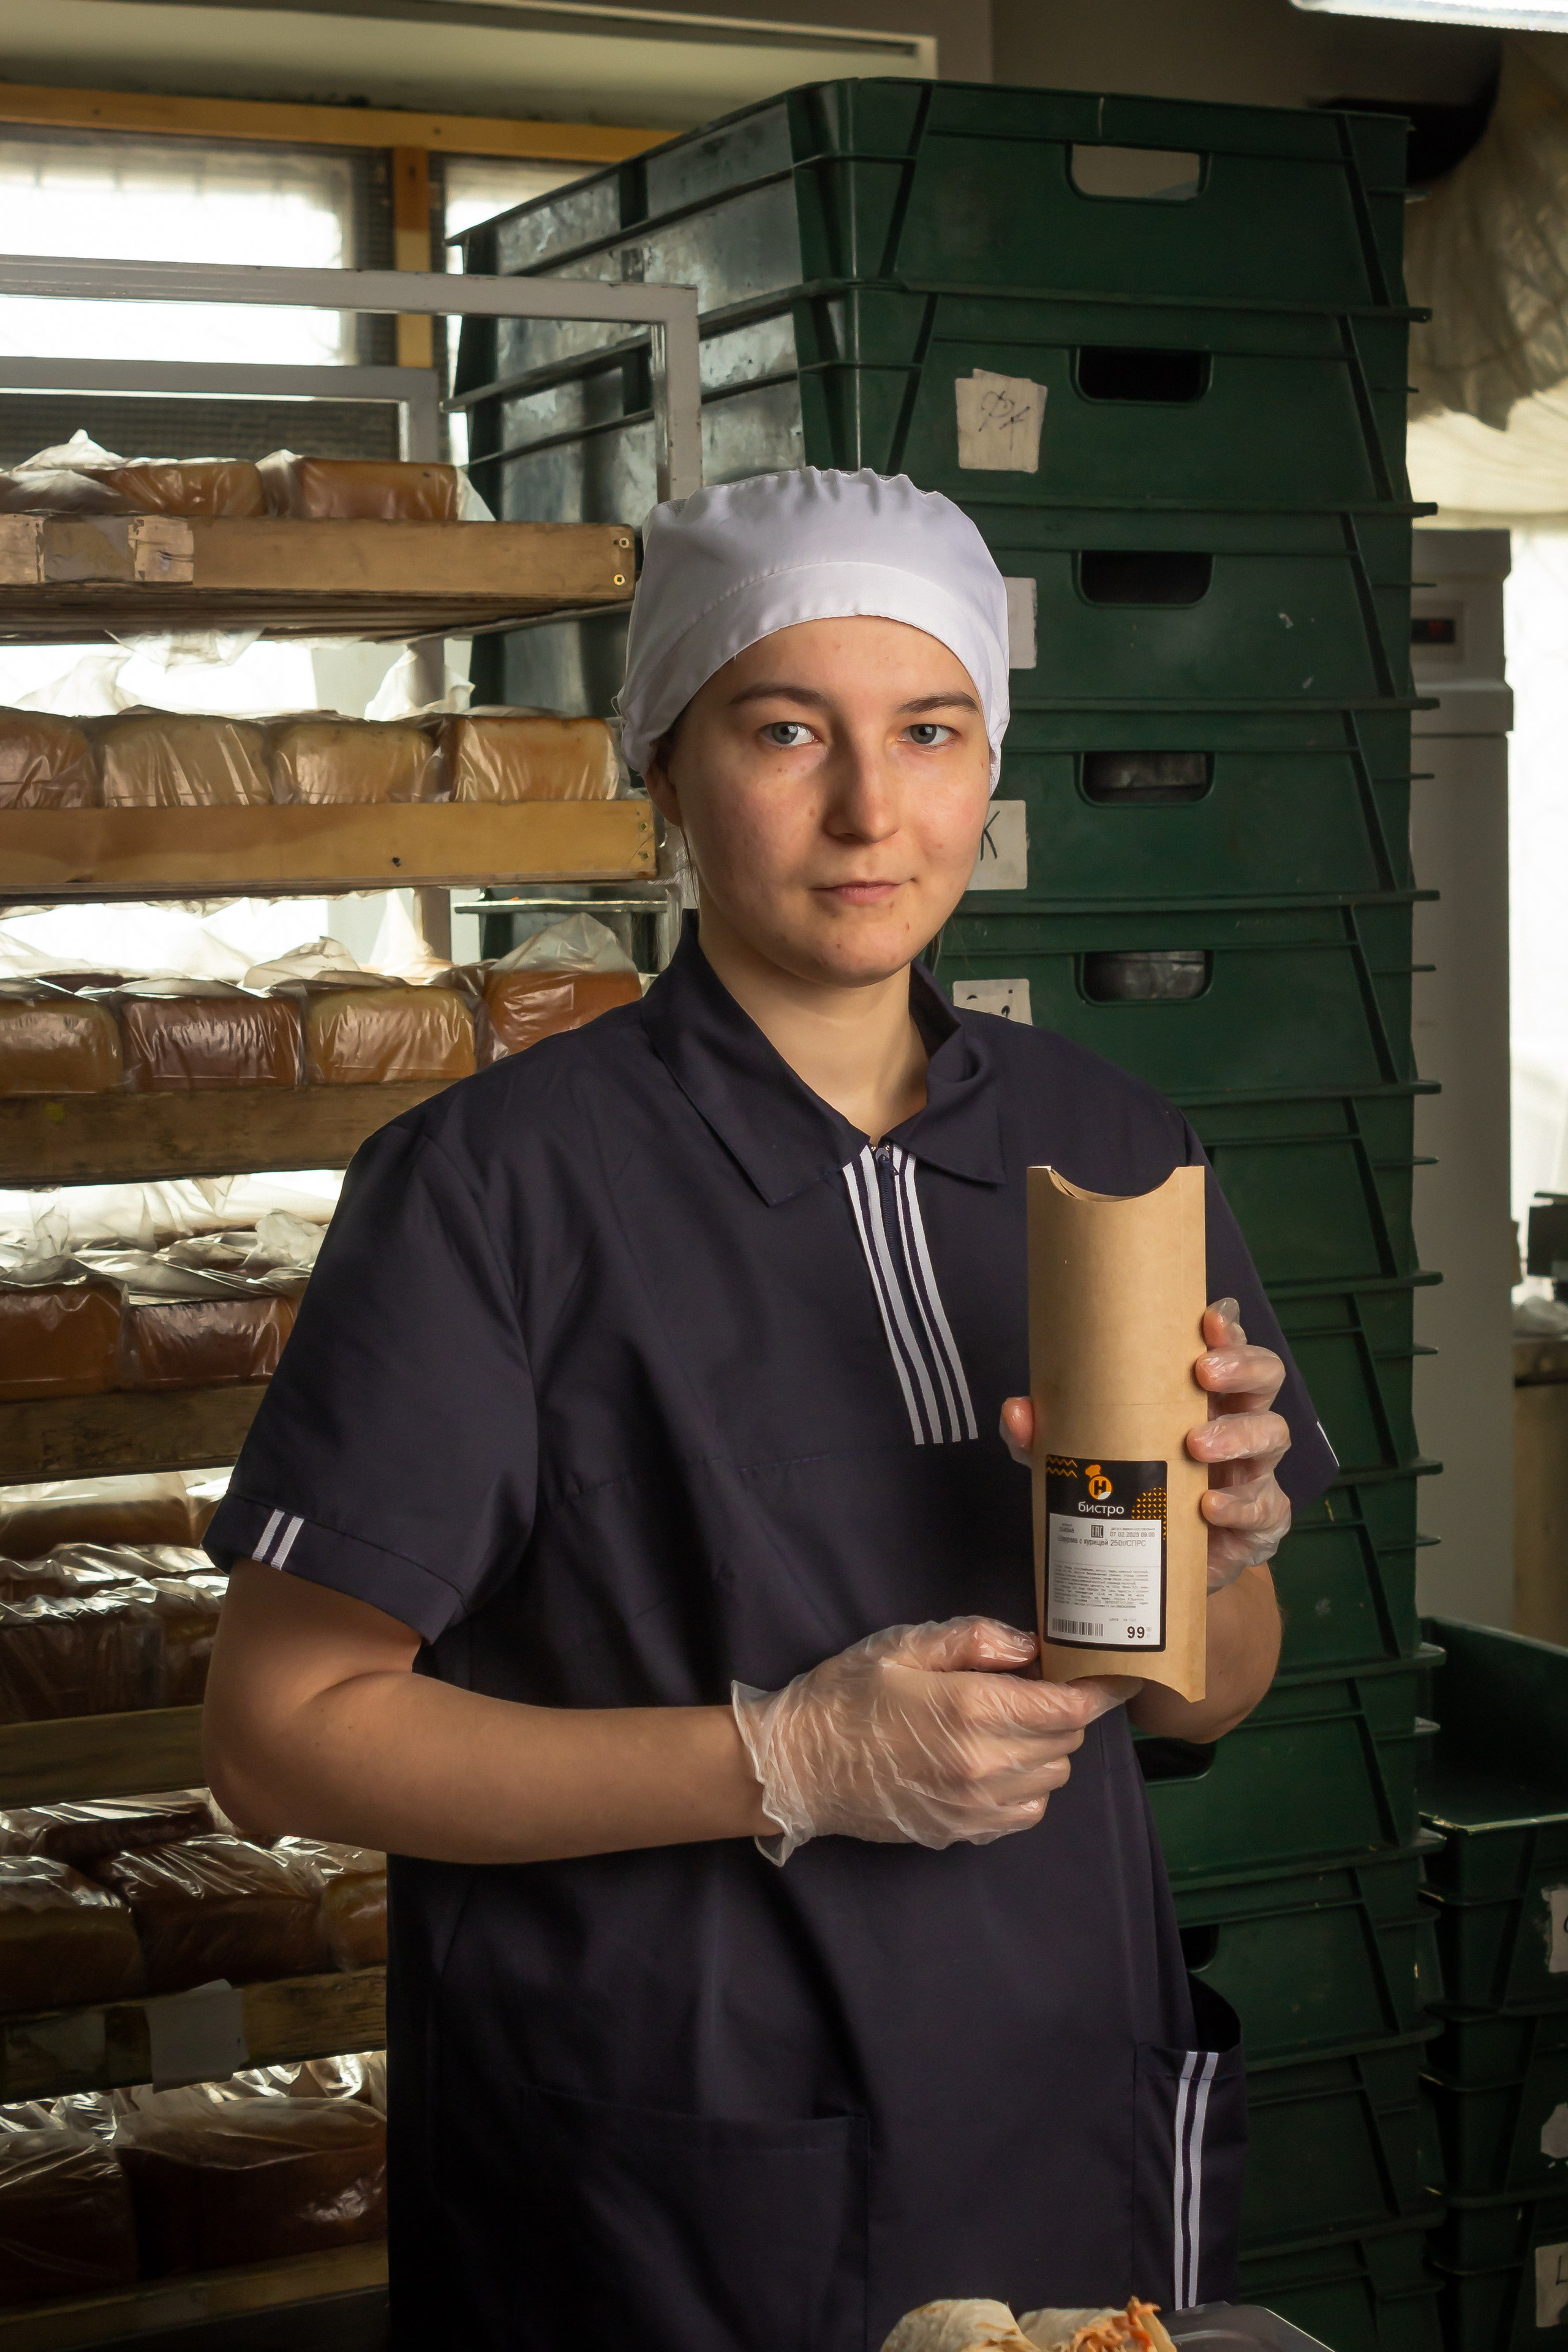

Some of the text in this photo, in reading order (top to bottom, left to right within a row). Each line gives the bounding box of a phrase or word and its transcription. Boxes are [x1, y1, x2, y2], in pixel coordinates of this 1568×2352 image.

[1078, 1501, 1125, 1517] бистро
[1084, 1539, 1108, 1547] курицей
[1127, 1626, 1145, 1639] 99
